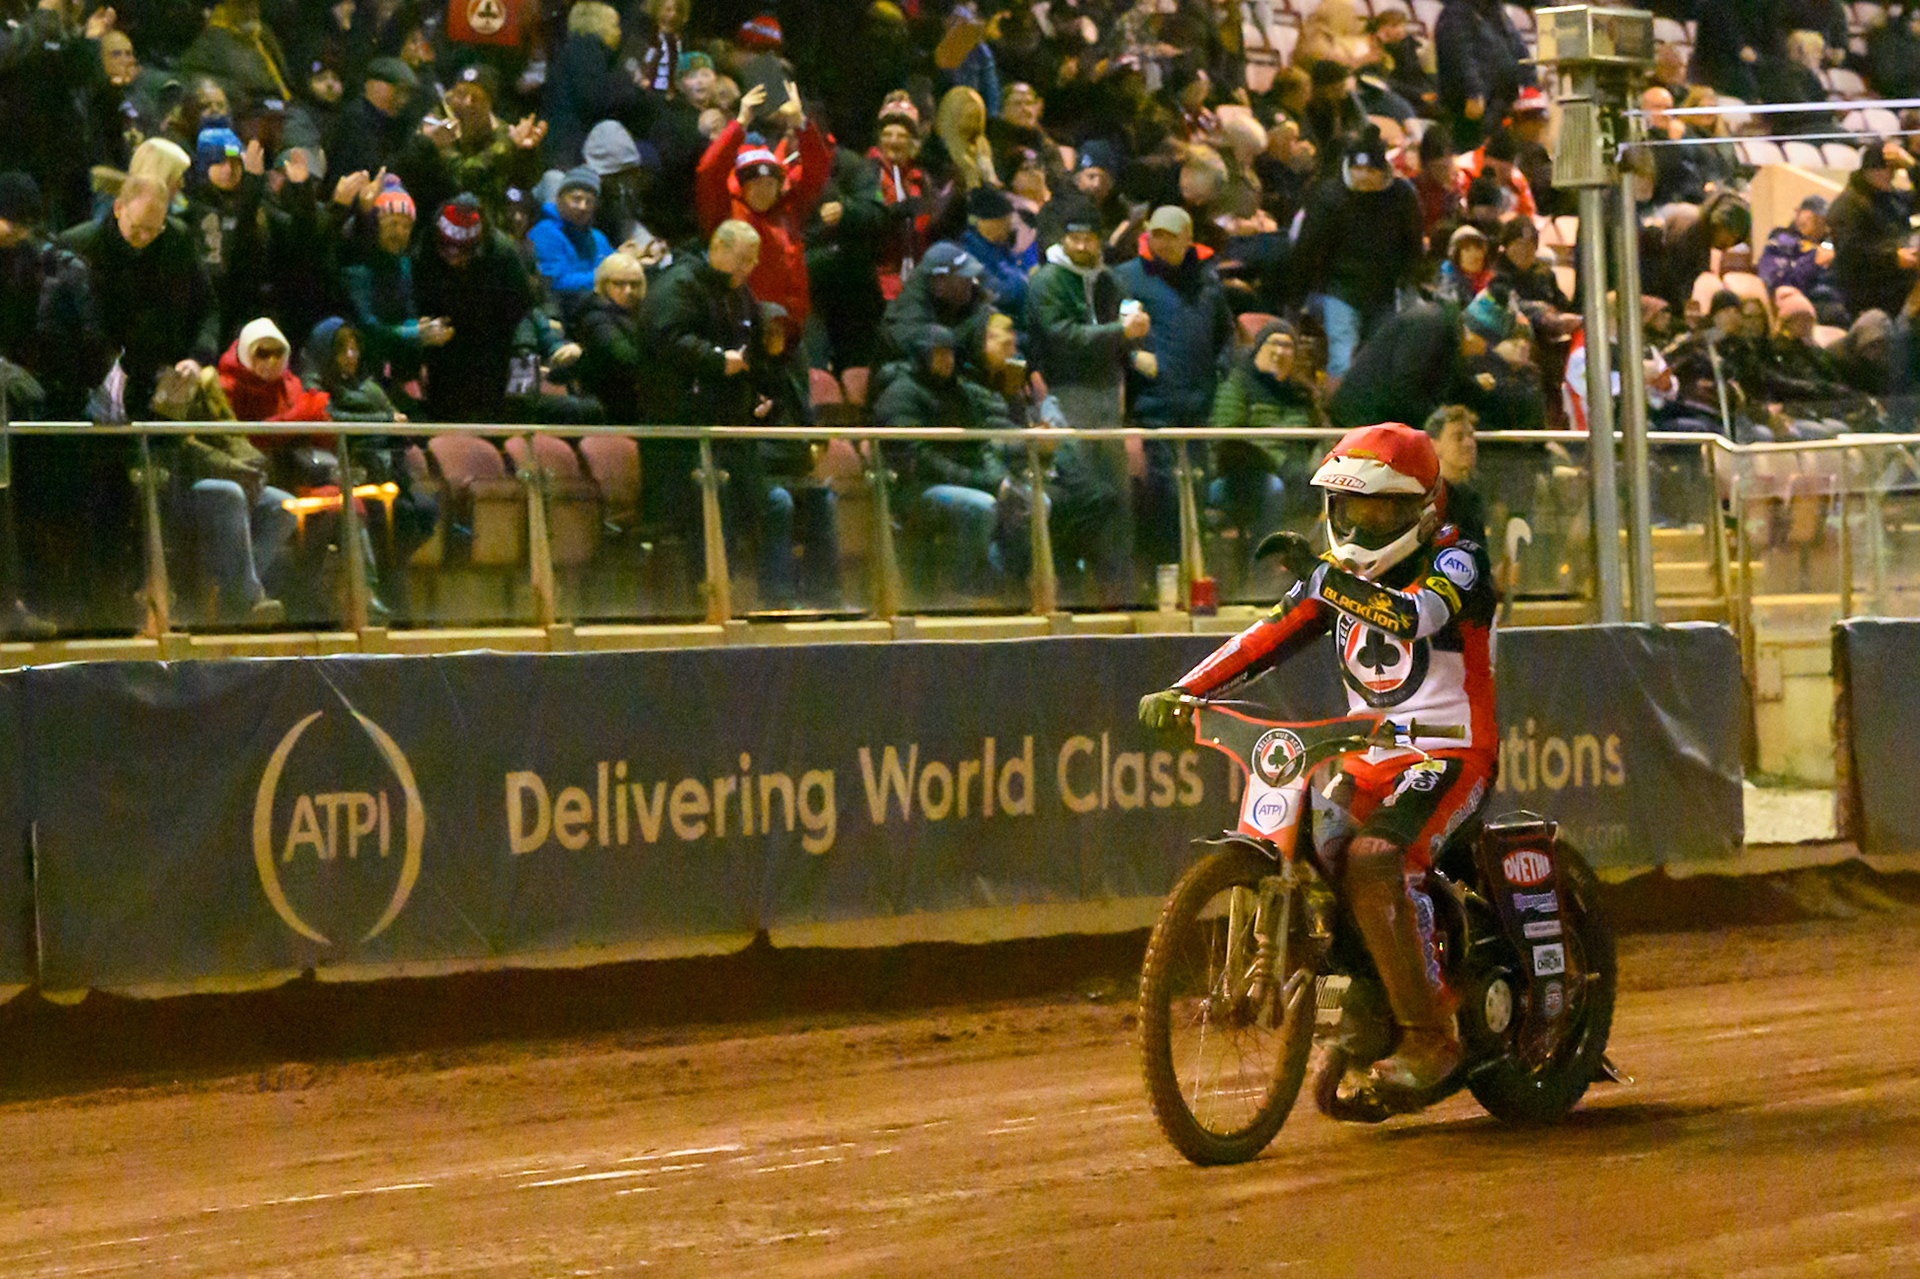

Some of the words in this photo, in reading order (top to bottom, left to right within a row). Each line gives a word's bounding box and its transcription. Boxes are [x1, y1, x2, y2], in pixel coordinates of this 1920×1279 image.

[1322, 586, 1400, 632] BLACKLION
[1340, 613, 1354, 647] BELL
[505, 751, 836, 856] Delivering
[858, 735, 1034, 826] World
[1057, 731, 1204, 814] Class
[1257, 803, 1283, 816] ATPI
[282, 790, 391, 864] ATPI
